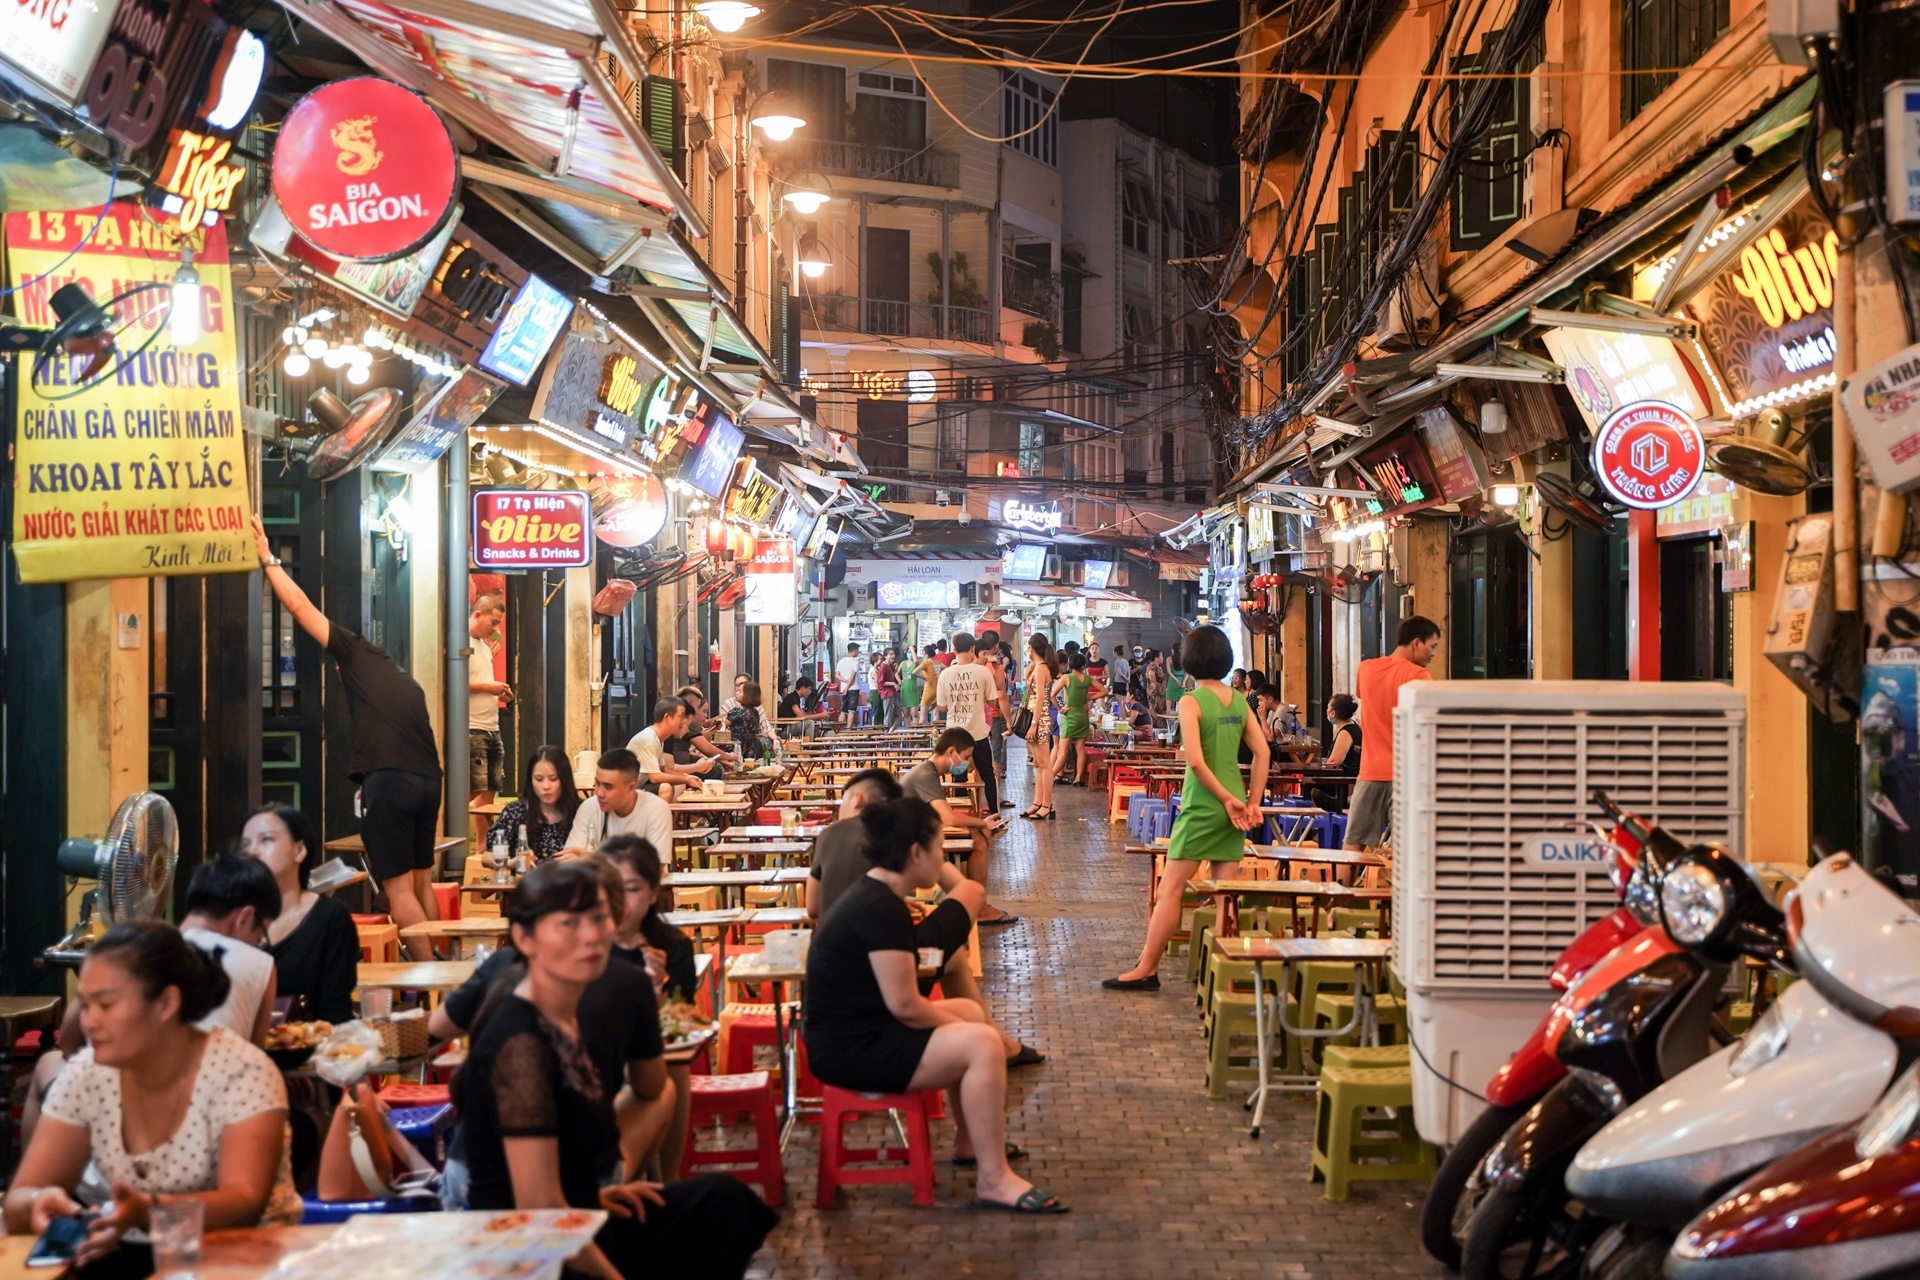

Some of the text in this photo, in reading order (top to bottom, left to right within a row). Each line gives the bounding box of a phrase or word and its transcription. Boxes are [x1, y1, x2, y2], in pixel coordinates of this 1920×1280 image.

[88, 43, 167, 149] OLD
[166, 129, 246, 234] Tiger
[346, 181, 382, 201] BIA
[308, 193, 422, 230] SAIGON
[27, 210, 67, 242] 13
[74, 214, 123, 252] TẠ
[115, 345, 220, 389] NƯỚNG
[1779, 334, 1833, 373] Snacks
[606, 356, 642, 417] Olive
[849, 369, 904, 400] Tiger
[24, 399, 235, 440] CHÂN GÀ CHIÊN MẮM
[1632, 410, 1660, 420] TNHH
[29, 446, 232, 493] KHOAI TÂY LẮC
[497, 497, 565, 512] 17 Tạ Hiện
[1004, 500, 1054, 530] Carlsberg
[23, 502, 244, 540] NƯỚC GIẢI KHÁT CÁC LOẠI
[481, 515, 581, 543] Olive
[483, 548, 580, 559] Snacks & Drinks
[755, 555, 790, 564] SAIGON
[922, 566, 941, 574] LOAN
[949, 681, 979, 692] MAMA
[957, 671, 971, 681] MY
[952, 714, 971, 725] YOU
[954, 704, 973, 714] LIKE
[1541, 843, 1603, 862] DAIKI
